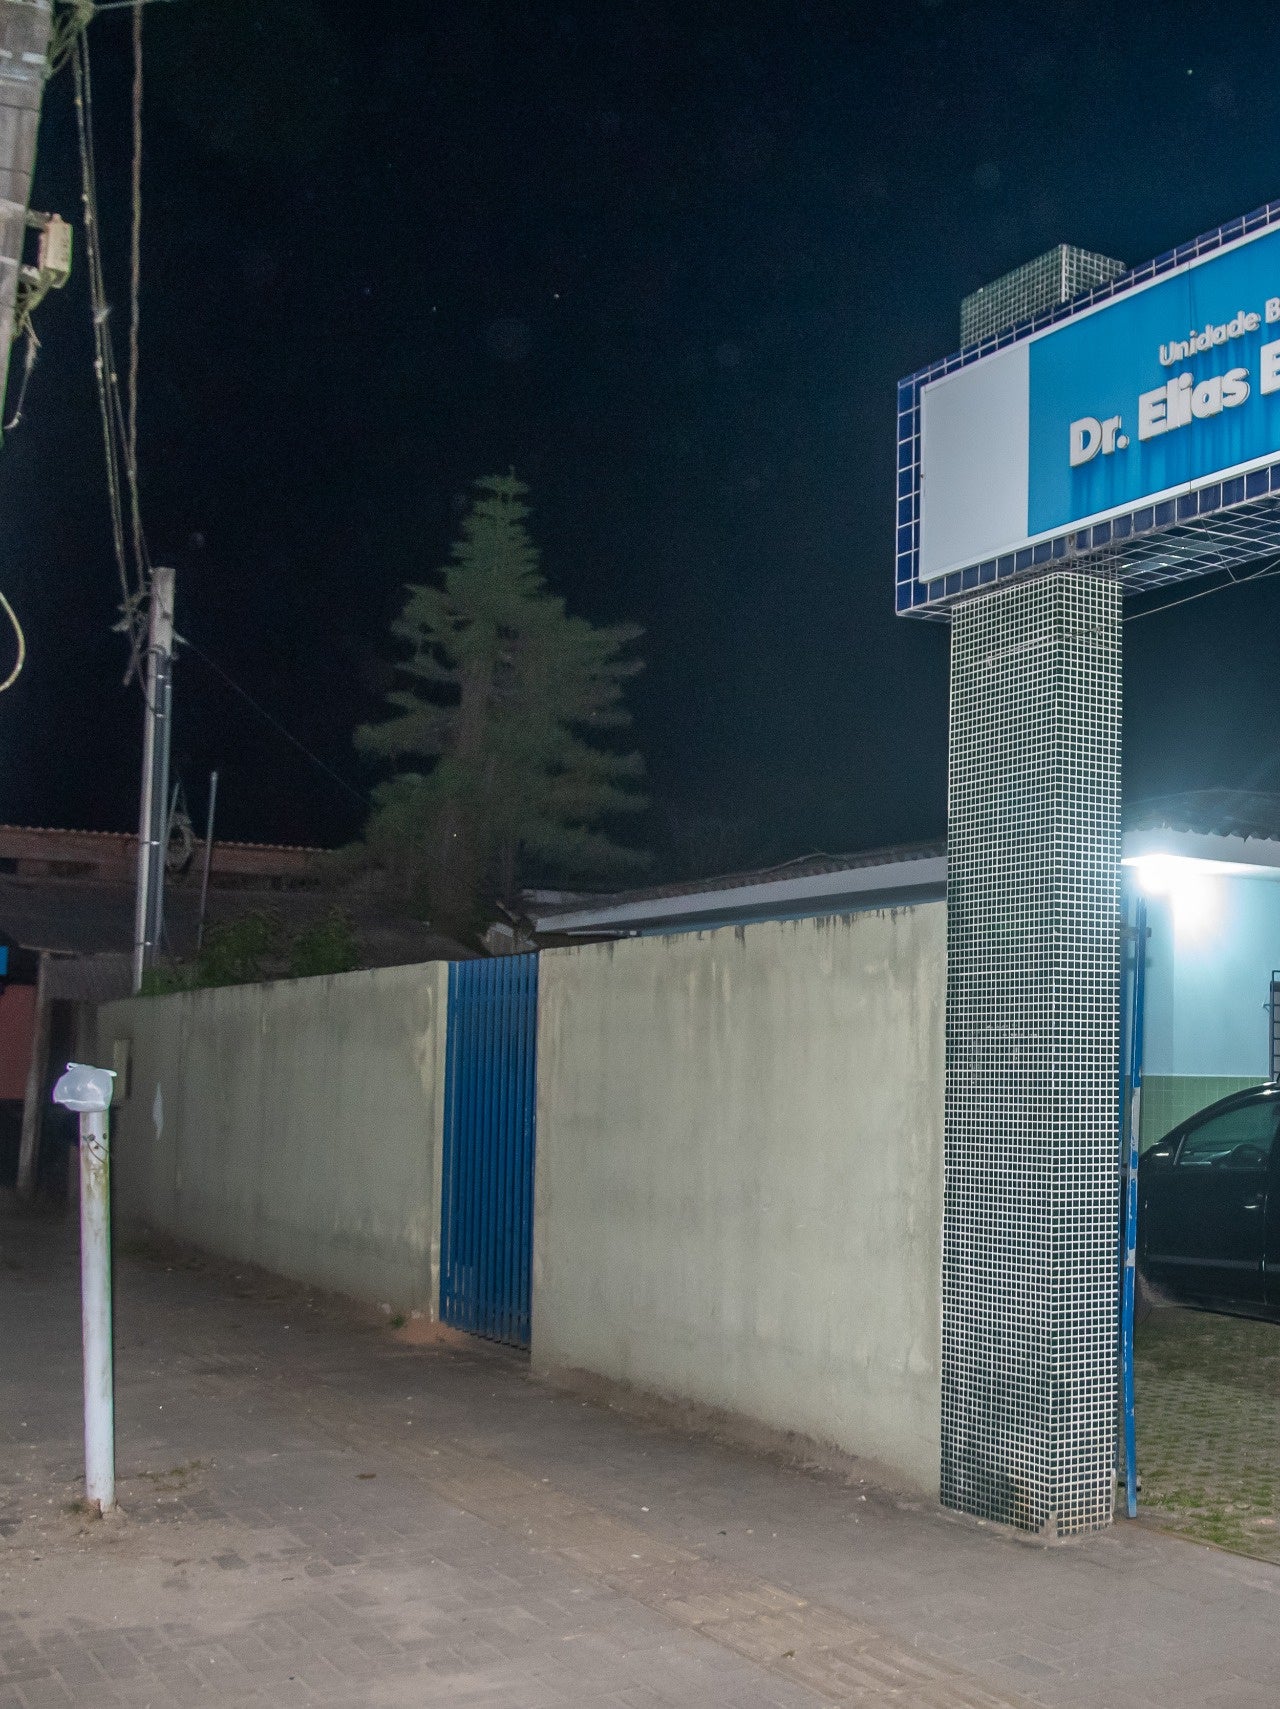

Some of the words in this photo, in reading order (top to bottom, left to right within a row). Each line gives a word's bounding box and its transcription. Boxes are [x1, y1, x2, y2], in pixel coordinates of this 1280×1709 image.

[1158, 309, 1260, 367] Unidade
[1069, 414, 1131, 468] Dr.
[1138, 365, 1251, 442] Elias
